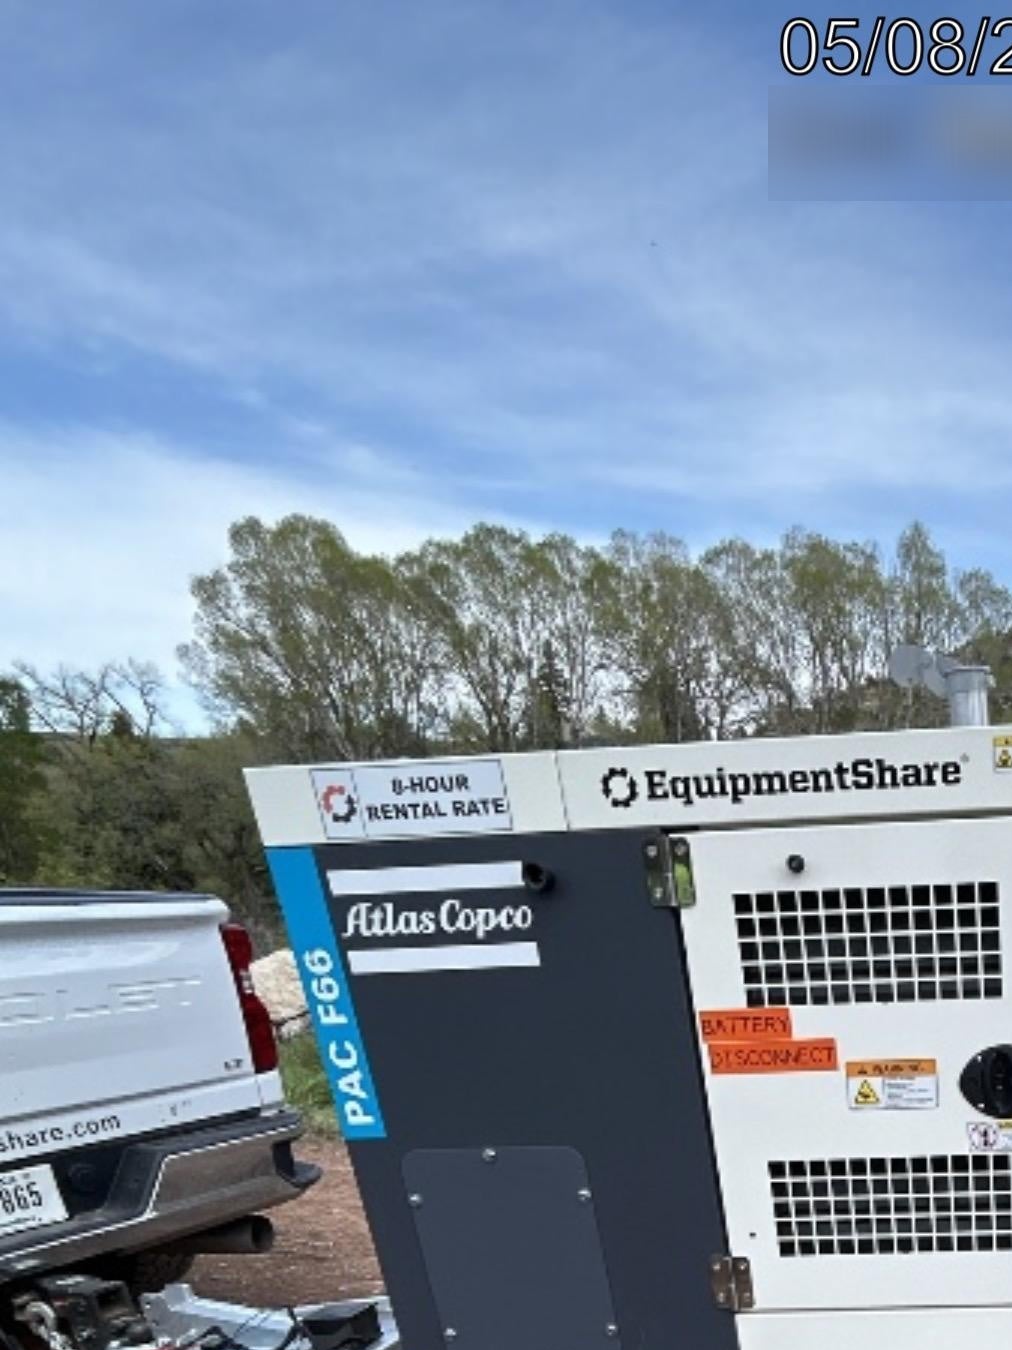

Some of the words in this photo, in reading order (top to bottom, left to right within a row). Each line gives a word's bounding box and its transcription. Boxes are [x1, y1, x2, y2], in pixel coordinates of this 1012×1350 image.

[643, 757, 963, 805] EquipmentShare
[365, 801, 448, 821] RENTAL
[452, 797, 507, 816] RATE
[341, 902, 436, 939] Atlas
[440, 899, 533, 940] Copco
[303, 948, 349, 1026] F66
[700, 1016, 788, 1036] BATTERY
[711, 1046, 835, 1069] DISCONNECT
[334, 1040, 375, 1126] PAC
